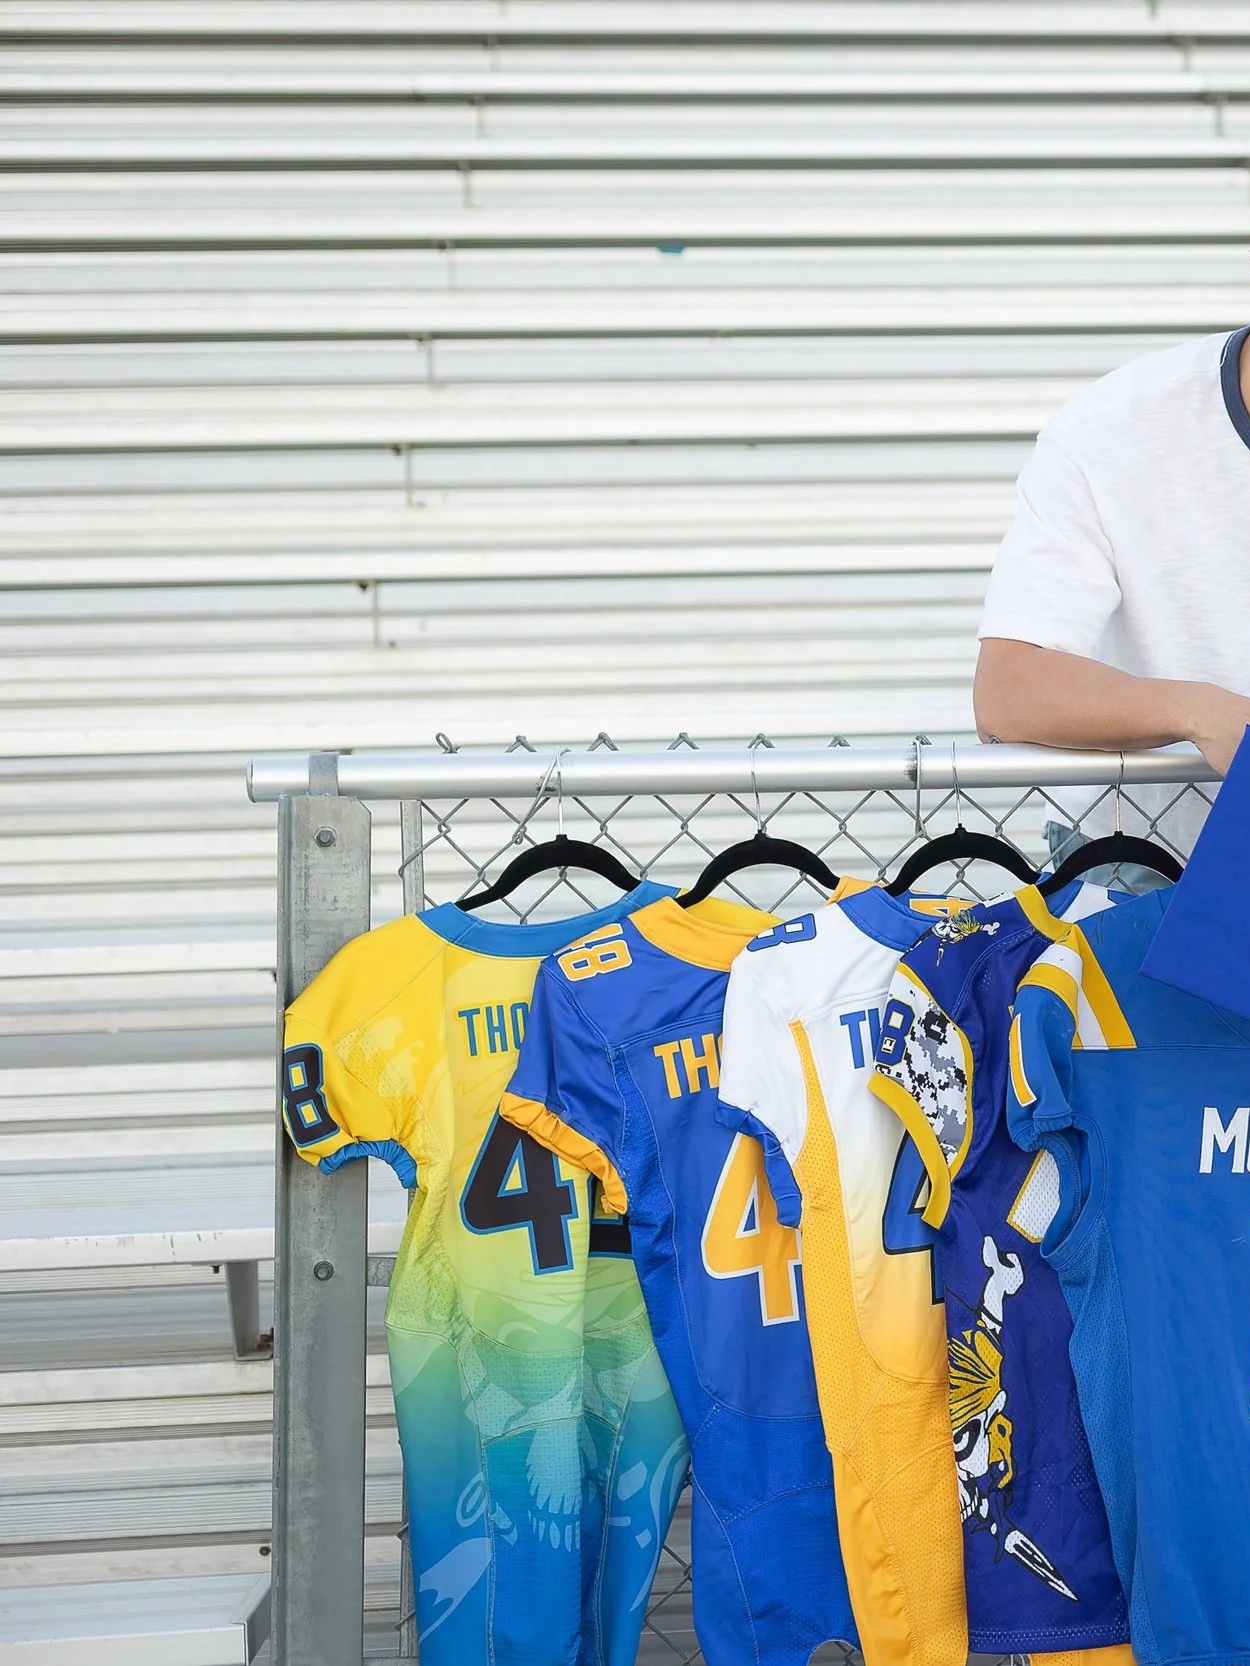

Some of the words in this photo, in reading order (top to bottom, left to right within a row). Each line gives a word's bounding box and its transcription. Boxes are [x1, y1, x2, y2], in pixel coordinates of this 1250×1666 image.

[653, 1033, 723, 1099] TH
[875, 998, 916, 1067] 8
[283, 1042, 341, 1149] 8
[701, 1131, 803, 1327] 4
